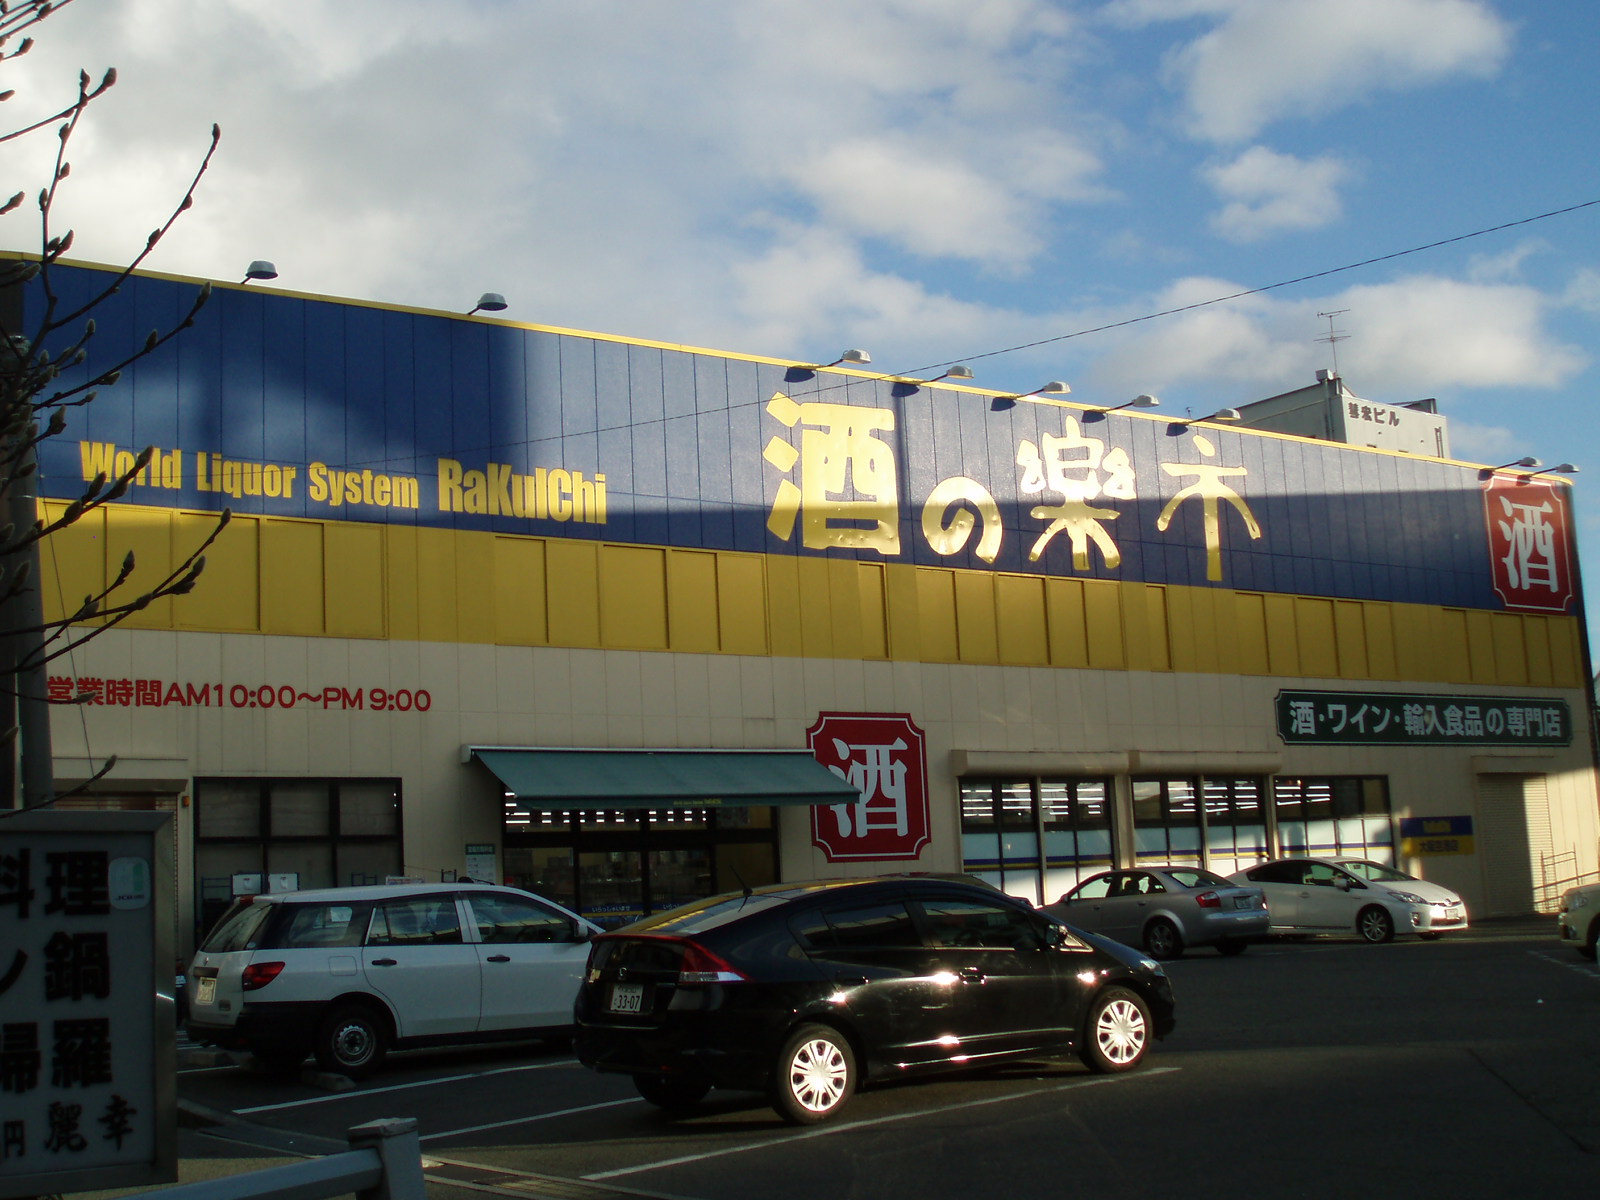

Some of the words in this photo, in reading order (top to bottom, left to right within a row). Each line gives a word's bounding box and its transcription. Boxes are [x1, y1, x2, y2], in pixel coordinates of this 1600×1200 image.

[80, 440, 182, 490] World
[196, 451, 297, 499] Liquor
[309, 461, 419, 509] System
[763, 392, 1262, 582] 酒の楽市
[1498, 494, 1560, 593] 酒
[827, 736, 909, 839] 酒
